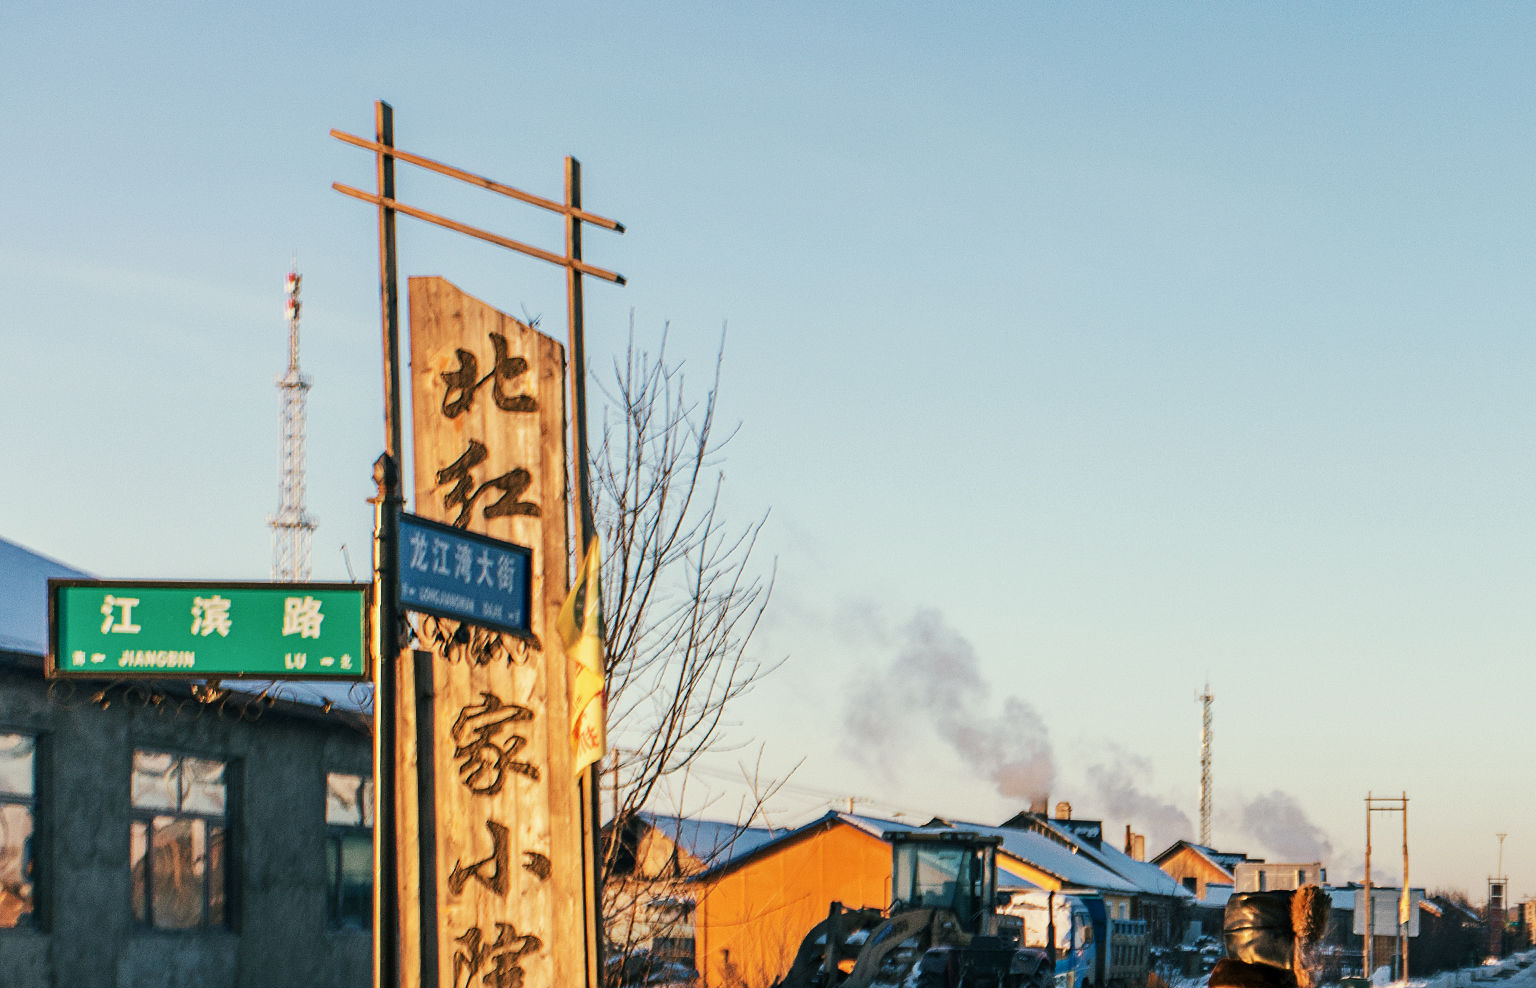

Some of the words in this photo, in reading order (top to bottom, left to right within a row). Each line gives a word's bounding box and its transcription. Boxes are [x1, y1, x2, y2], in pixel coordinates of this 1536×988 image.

[410, 531, 515, 594] 龙江湾大街
[101, 595, 325, 639] 江滨路
[118, 650, 195, 668] JIANGBIN
[285, 652, 307, 669] LU
